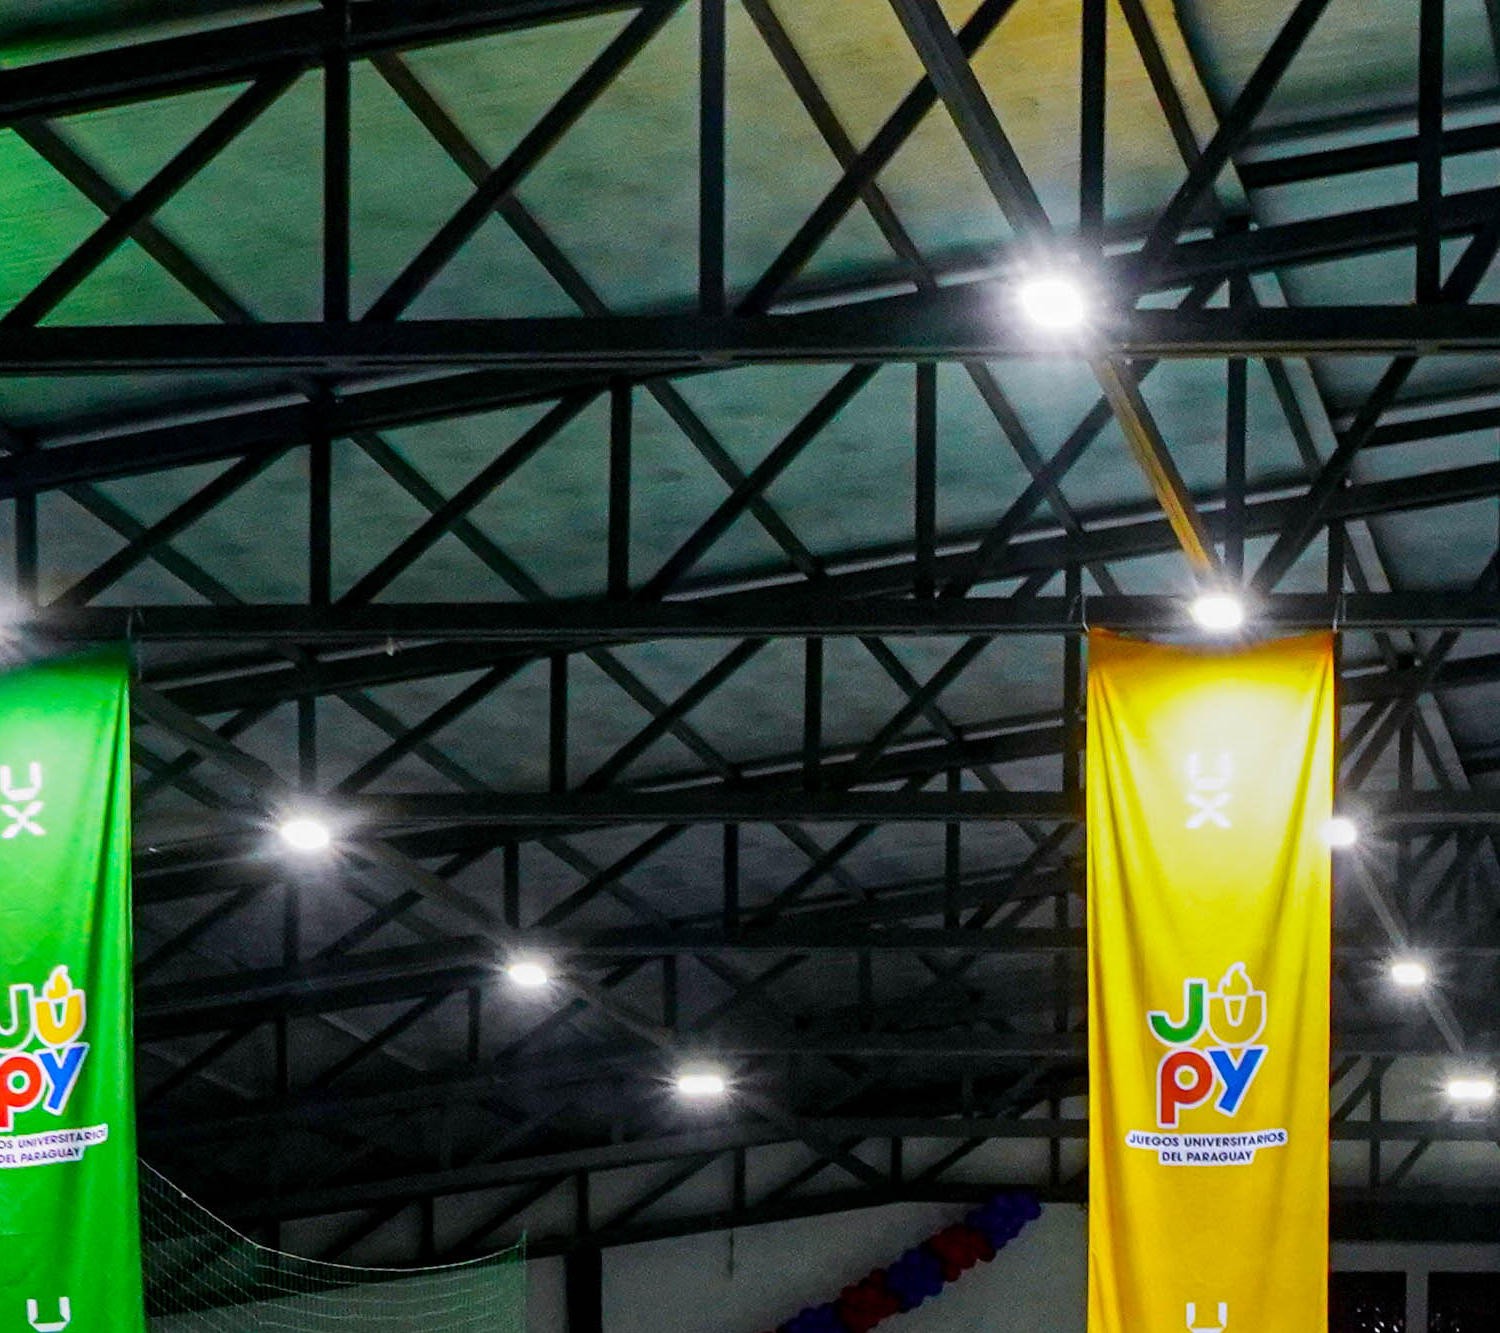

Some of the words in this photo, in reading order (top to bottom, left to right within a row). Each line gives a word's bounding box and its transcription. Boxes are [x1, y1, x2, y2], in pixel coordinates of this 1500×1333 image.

[1129, 1130, 1179, 1148] JUEGOS
[20, 1147, 80, 1163] PARAGUAY
[1161, 1150, 1183, 1163] DEL
[1186, 1149, 1254, 1162] PARAGUAY
